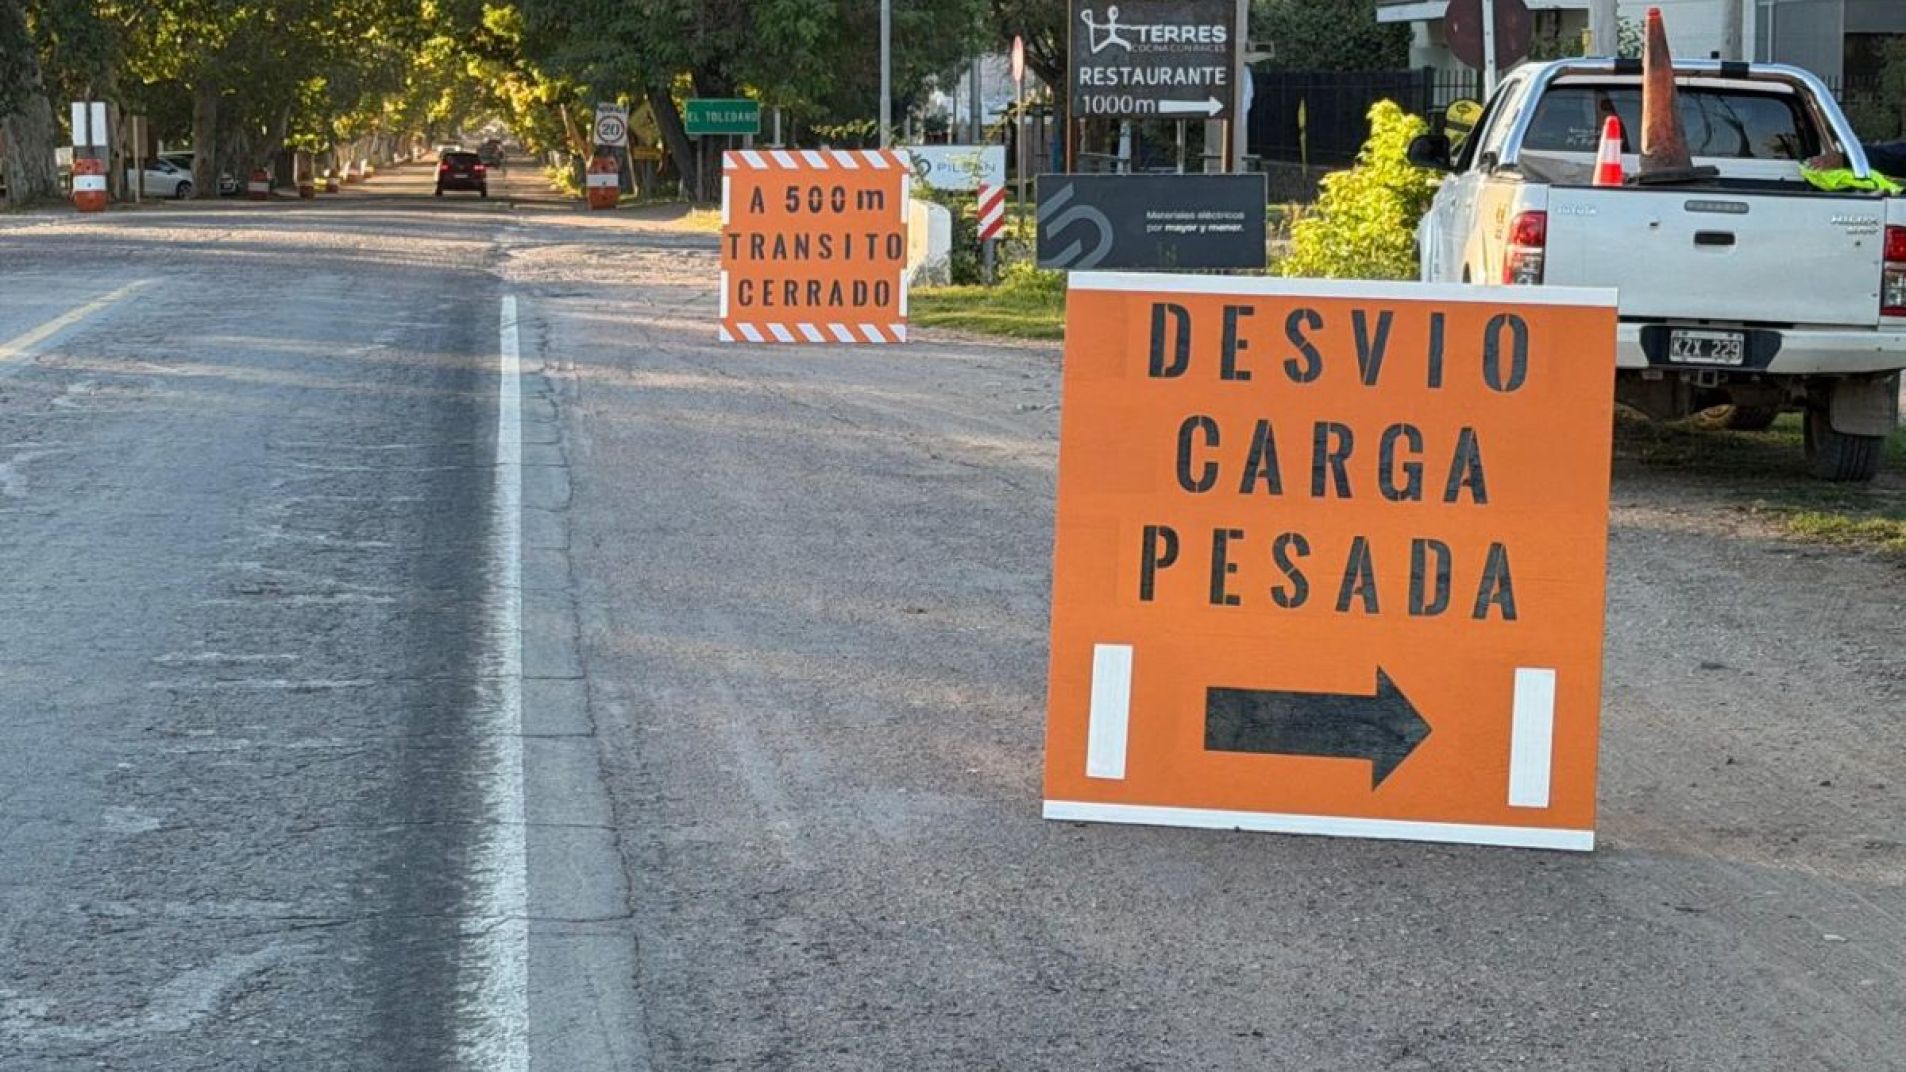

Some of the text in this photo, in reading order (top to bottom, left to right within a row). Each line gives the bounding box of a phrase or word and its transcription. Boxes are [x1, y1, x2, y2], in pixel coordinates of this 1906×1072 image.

[1139, 24, 1227, 43] TERRES
[1079, 66, 1227, 86] RESTAURANTE
[687, 111, 758, 124] EL TOLEDANO
[601, 123, 620, 136] 20
[750, 186, 884, 214] A 500 m
[1146, 211, 1195, 220] Materiales
[1146, 224, 1162, 234] por
[1165, 224, 1197, 234] mayor
[728, 233, 902, 261] TRANSITO
[738, 279, 890, 307] CERRADO
[1148, 302, 1530, 393] DESVIO
[1672, 338, 1740, 360] KZX 229
[1175, 414, 1489, 505] CARGA
[1139, 524, 1518, 621] PESADA
